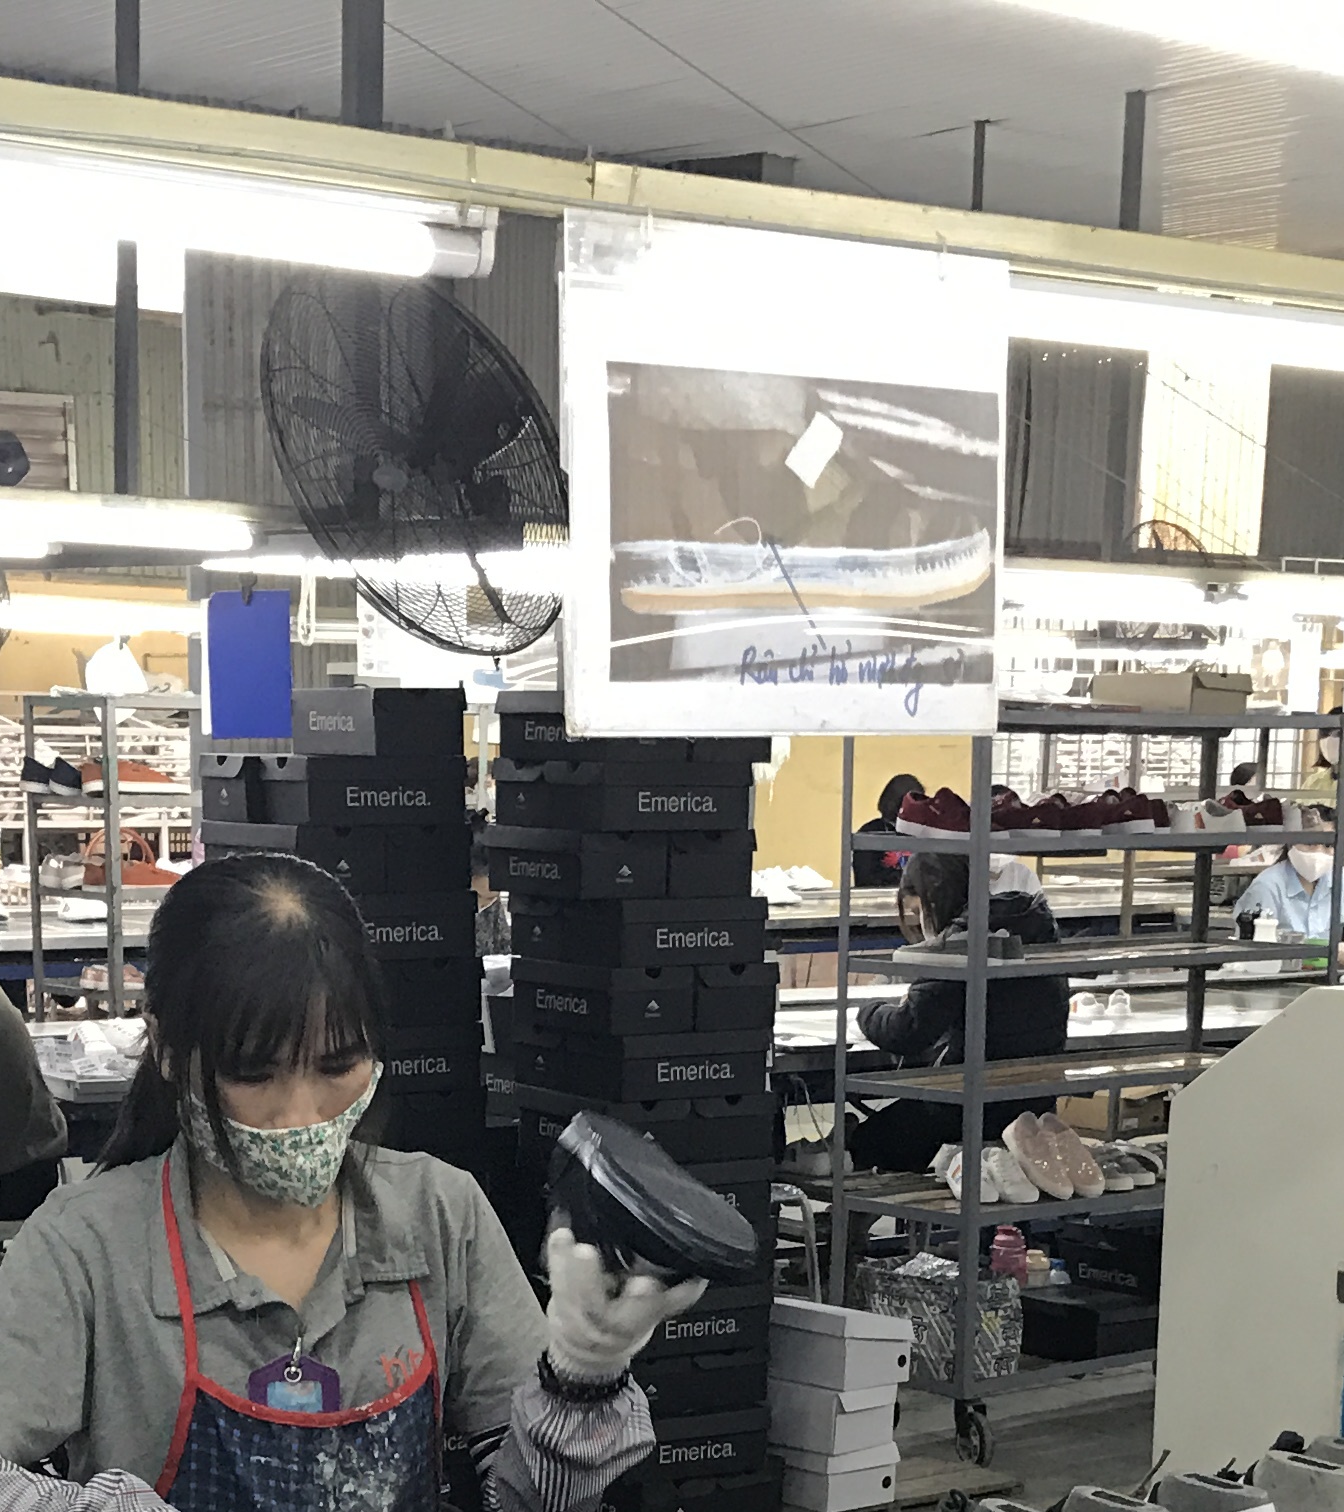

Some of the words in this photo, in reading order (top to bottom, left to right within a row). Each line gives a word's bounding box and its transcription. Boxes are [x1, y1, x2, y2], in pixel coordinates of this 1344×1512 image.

[309, 711, 355, 732] Emerica.
[346, 786, 431, 807] Emerica.
[638, 792, 717, 813] Emerica.
[509, 857, 561, 880] Emerica.
[656, 928, 734, 949] Emerica.
[657, 1060, 735, 1082] Emerica.
[665, 1316, 739, 1339] Emerica.
[659, 1441, 736, 1464] Emerica.
